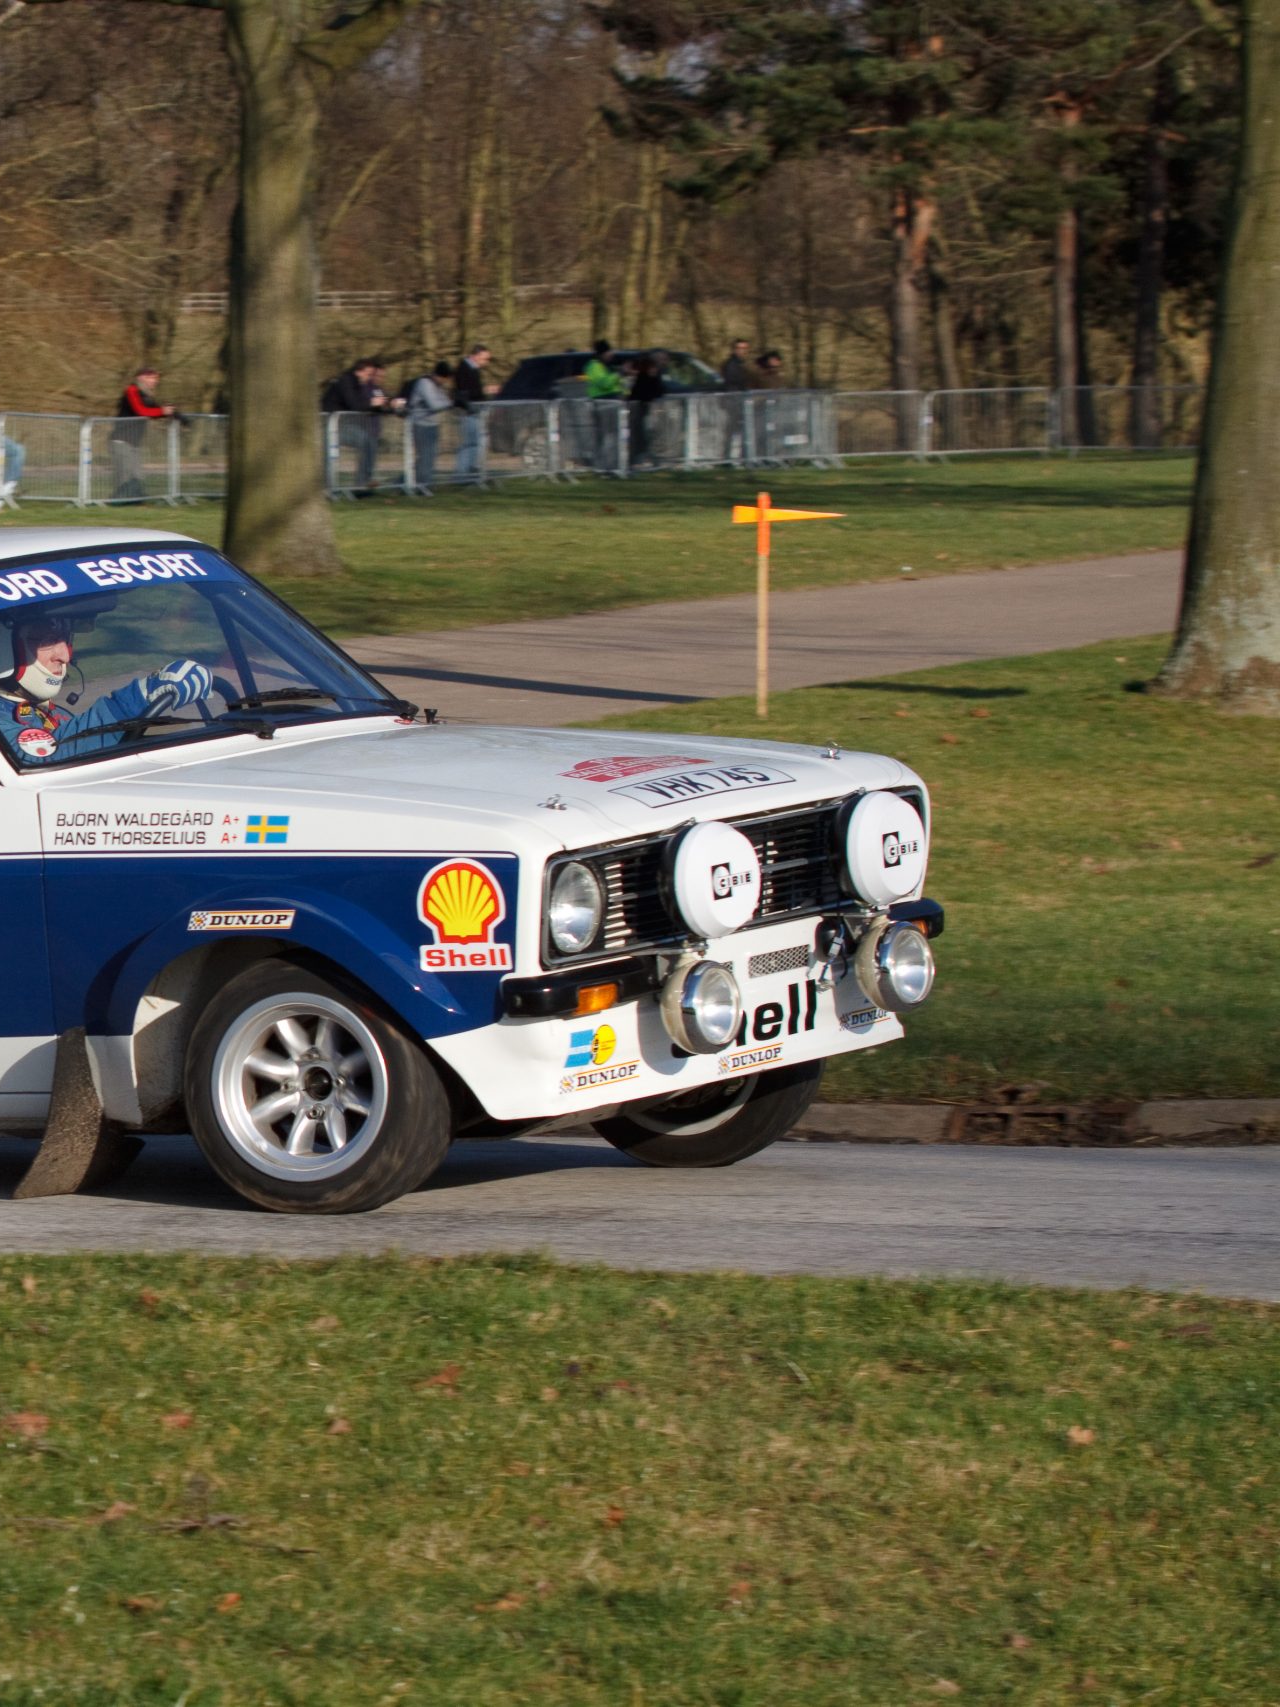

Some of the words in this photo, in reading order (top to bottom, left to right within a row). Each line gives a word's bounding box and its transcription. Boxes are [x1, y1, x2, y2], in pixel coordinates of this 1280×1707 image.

[76, 553, 208, 586] ESCORT
[635, 773, 714, 799] VHK
[56, 811, 108, 827] BJÖRN
[115, 810, 213, 826] WALDEGÅRD
[223, 814, 240, 826] A+
[54, 832, 96, 845] HANS
[102, 831, 206, 845] THORSZELIUS
[221, 832, 238, 844] A+
[209, 914, 288, 926] DUNLOP
[425, 948, 507, 966] Shell
[731, 1047, 782, 1068] DUNLOP
[576, 1064, 638, 1088] DUNLOP
